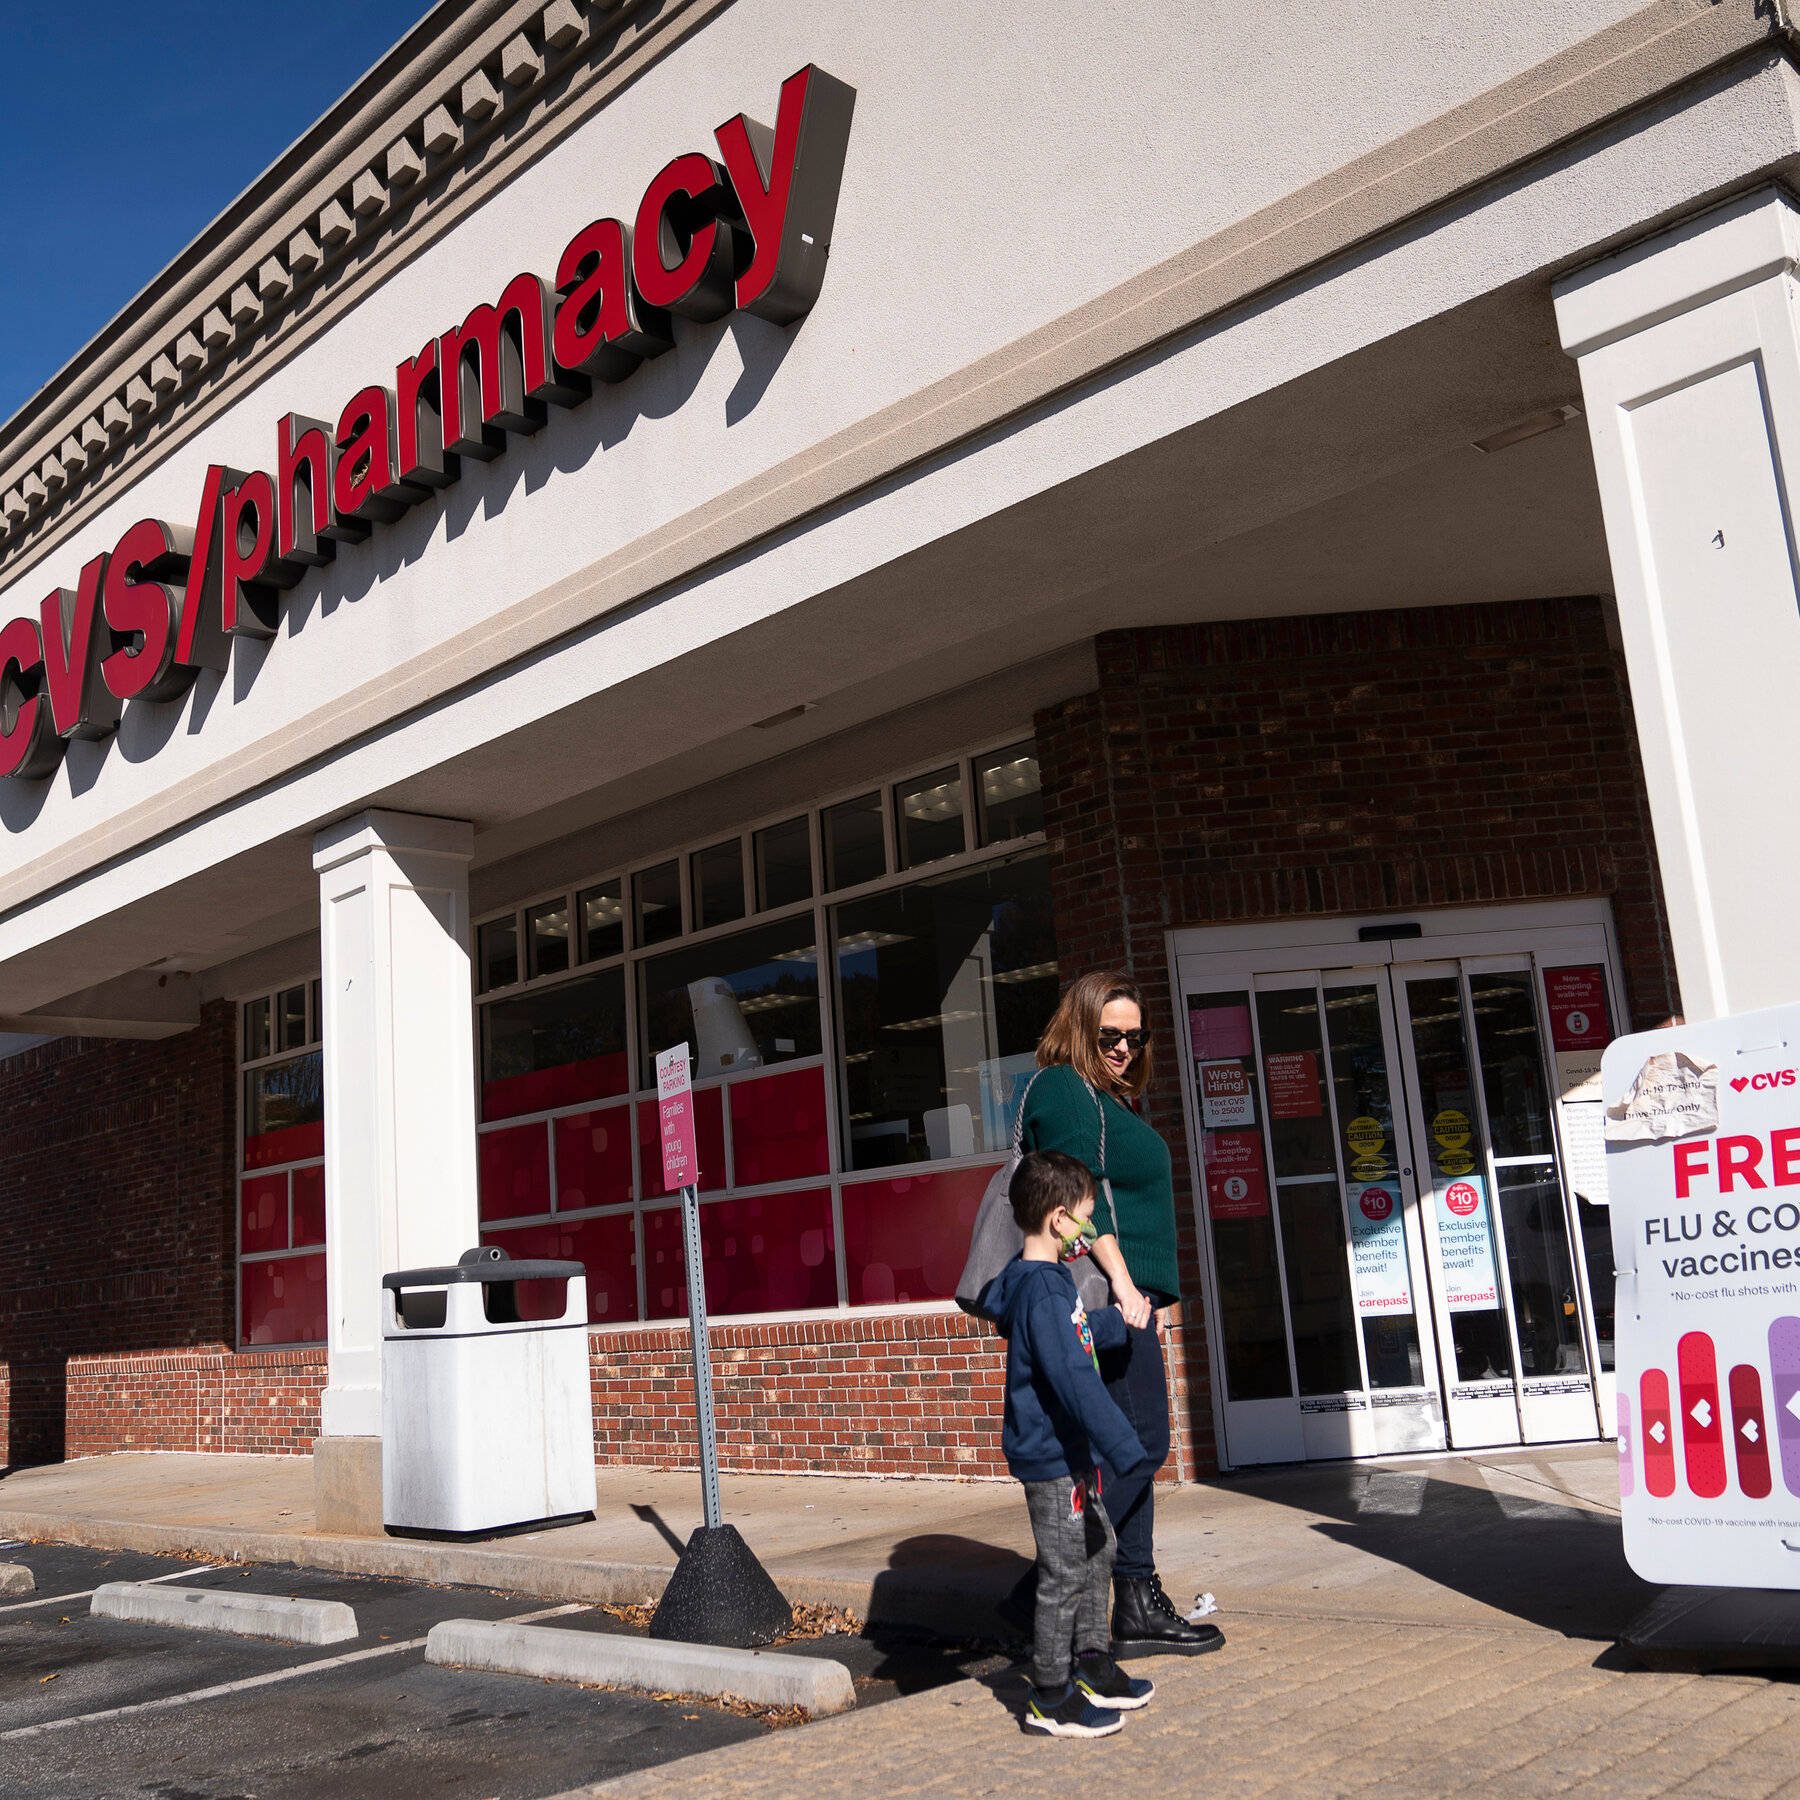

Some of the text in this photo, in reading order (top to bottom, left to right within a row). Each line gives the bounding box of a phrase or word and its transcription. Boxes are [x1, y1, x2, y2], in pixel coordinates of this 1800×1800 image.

[1554, 983, 1592, 992] accepting
[1268, 1055, 1304, 1064] WARNING
[660, 1059, 687, 1079] COURTESY
[1207, 1069, 1242, 1081] We're
[662, 1073, 685, 1092] PARKING
[1208, 1079, 1244, 1092] Hiring!
[1751, 1069, 1796, 1091] CVS
[1208, 1098, 1246, 1107] Text CVS
[1676, 1103, 1701, 1113] Only
[662, 1101, 685, 1120] Families
[1211, 1106, 1245, 1116] to 25000
[664, 1121, 675, 1136] with
[1434, 1124, 1469, 1135] CAUTION
[1348, 1130, 1384, 1141] CAUTION
[664, 1138, 682, 1156] young
[1221, 1139, 1241, 1147] Now
[1213, 1146, 1252, 1156] accepting
[665, 1154, 688, 1170] children
[1363, 1196, 1386, 1210] $10
[1448, 1191, 1472, 1205] $10
[1352, 1224, 1401, 1236] Exclusive
[1438, 1220, 1487, 1232] Exclusive
[1645, 1203, 1800, 1245] FLU & CO
[1353, 1237, 1399, 1249] member
[1440, 1233, 1485, 1244] member
[1355, 1250, 1398, 1262] benefits
[1442, 1245, 1485, 1257] benefits
[1356, 1262, 1387, 1274] await!
[1443, 1258, 1474, 1270] await!
[1722, 1288, 1735, 1297] flu
[1738, 1285, 1769, 1297] shots
[1771, 1282, 1797, 1295] with
[1359, 1297, 1409, 1308] carepass
[1447, 1292, 1496, 1303] carepass
[1684, 1517, 1723, 1526] COVID-19
[1725, 1519, 1757, 1528] vaccine
[1758, 1519, 1776, 1528] with
[1778, 1519, 1800, 1528] insur
